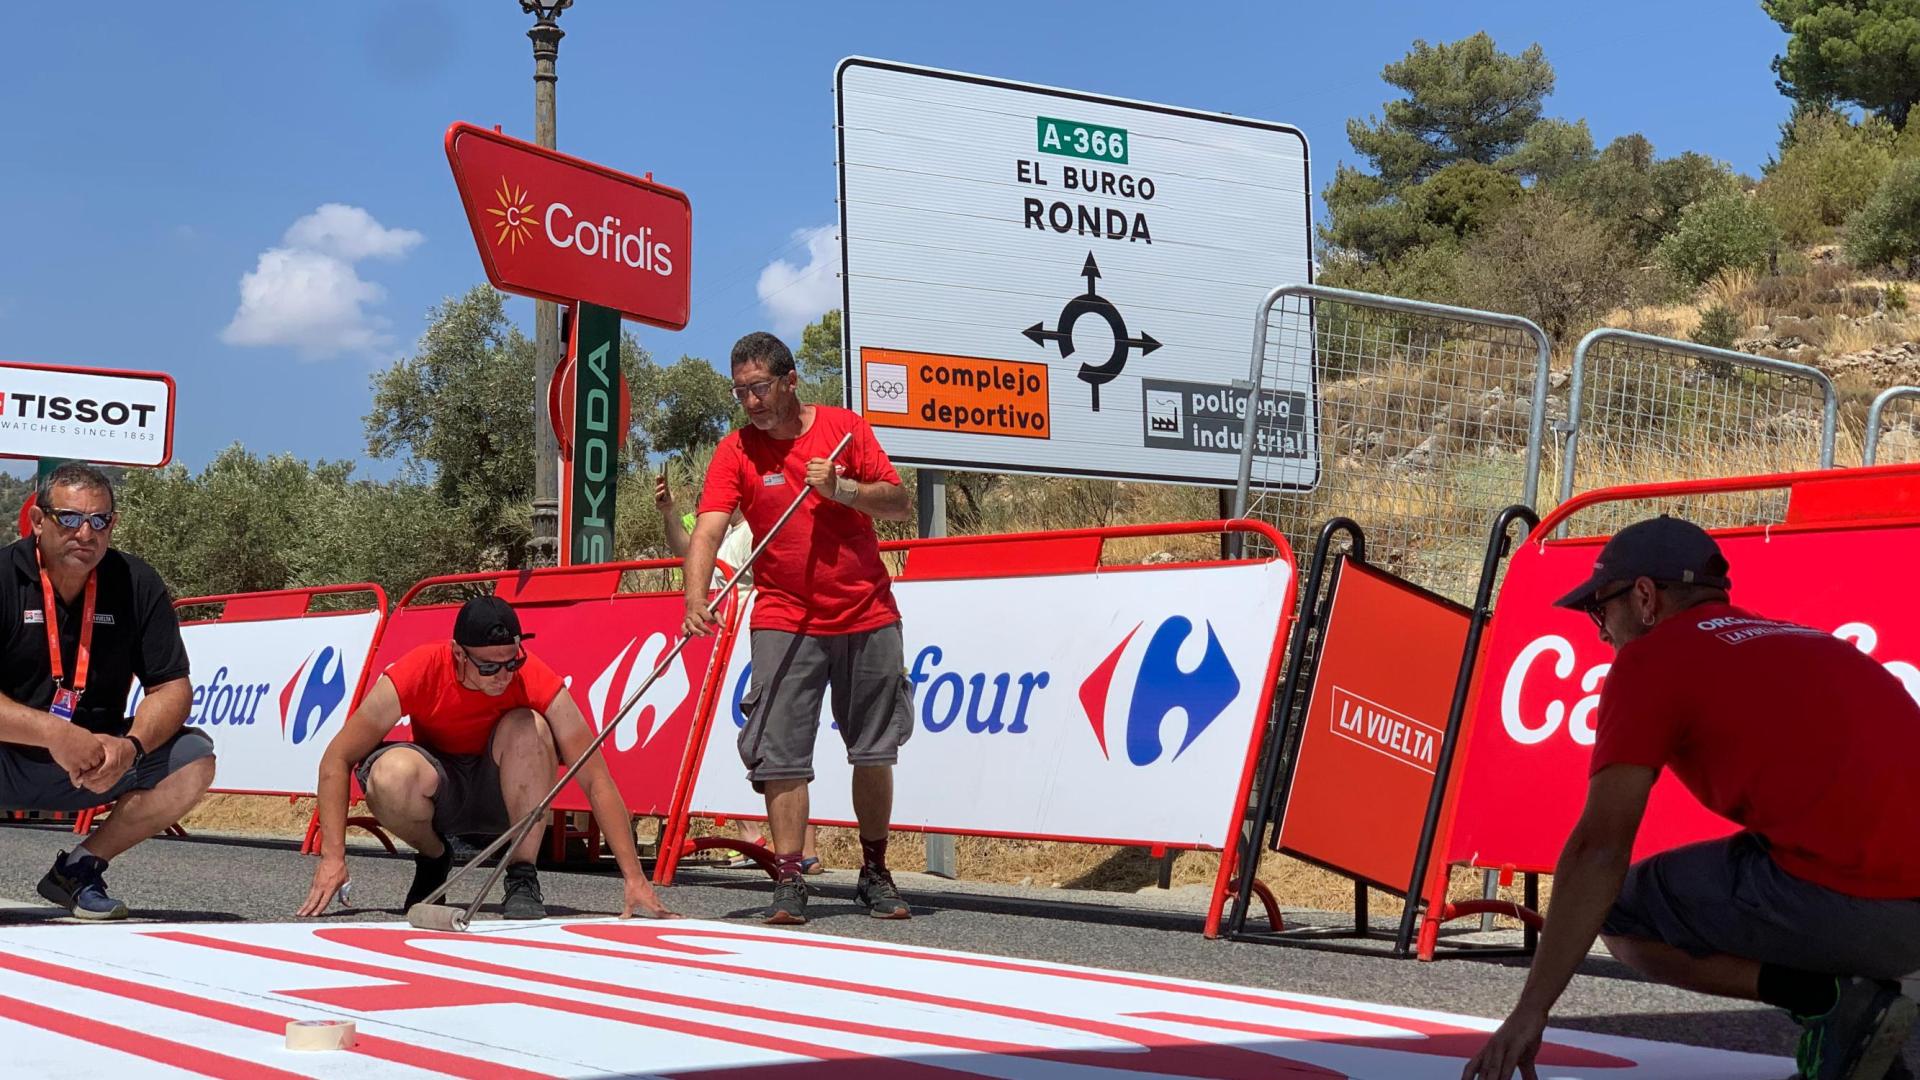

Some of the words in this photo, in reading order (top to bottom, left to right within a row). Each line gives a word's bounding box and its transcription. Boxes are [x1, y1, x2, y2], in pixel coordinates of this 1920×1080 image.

[1042, 123, 1124, 159] A-366
[1017, 159, 1047, 186] EL
[1063, 166, 1155, 200] BURGO
[1024, 197, 1152, 245] RONDA
[545, 202, 673, 276] Cofidis
[919, 365, 1041, 396] complejo
[11, 393, 156, 428] TISSOT
[921, 398, 1045, 430] deportivo
[1, 421, 66, 434] WATCHES
[74, 427, 116, 438] SINCE
[123, 431, 155, 441] 1853
[1192, 423, 1304, 454] indutrial
[1339, 700, 1363, 735] LA
[1367, 710, 1434, 764] VUELTA
